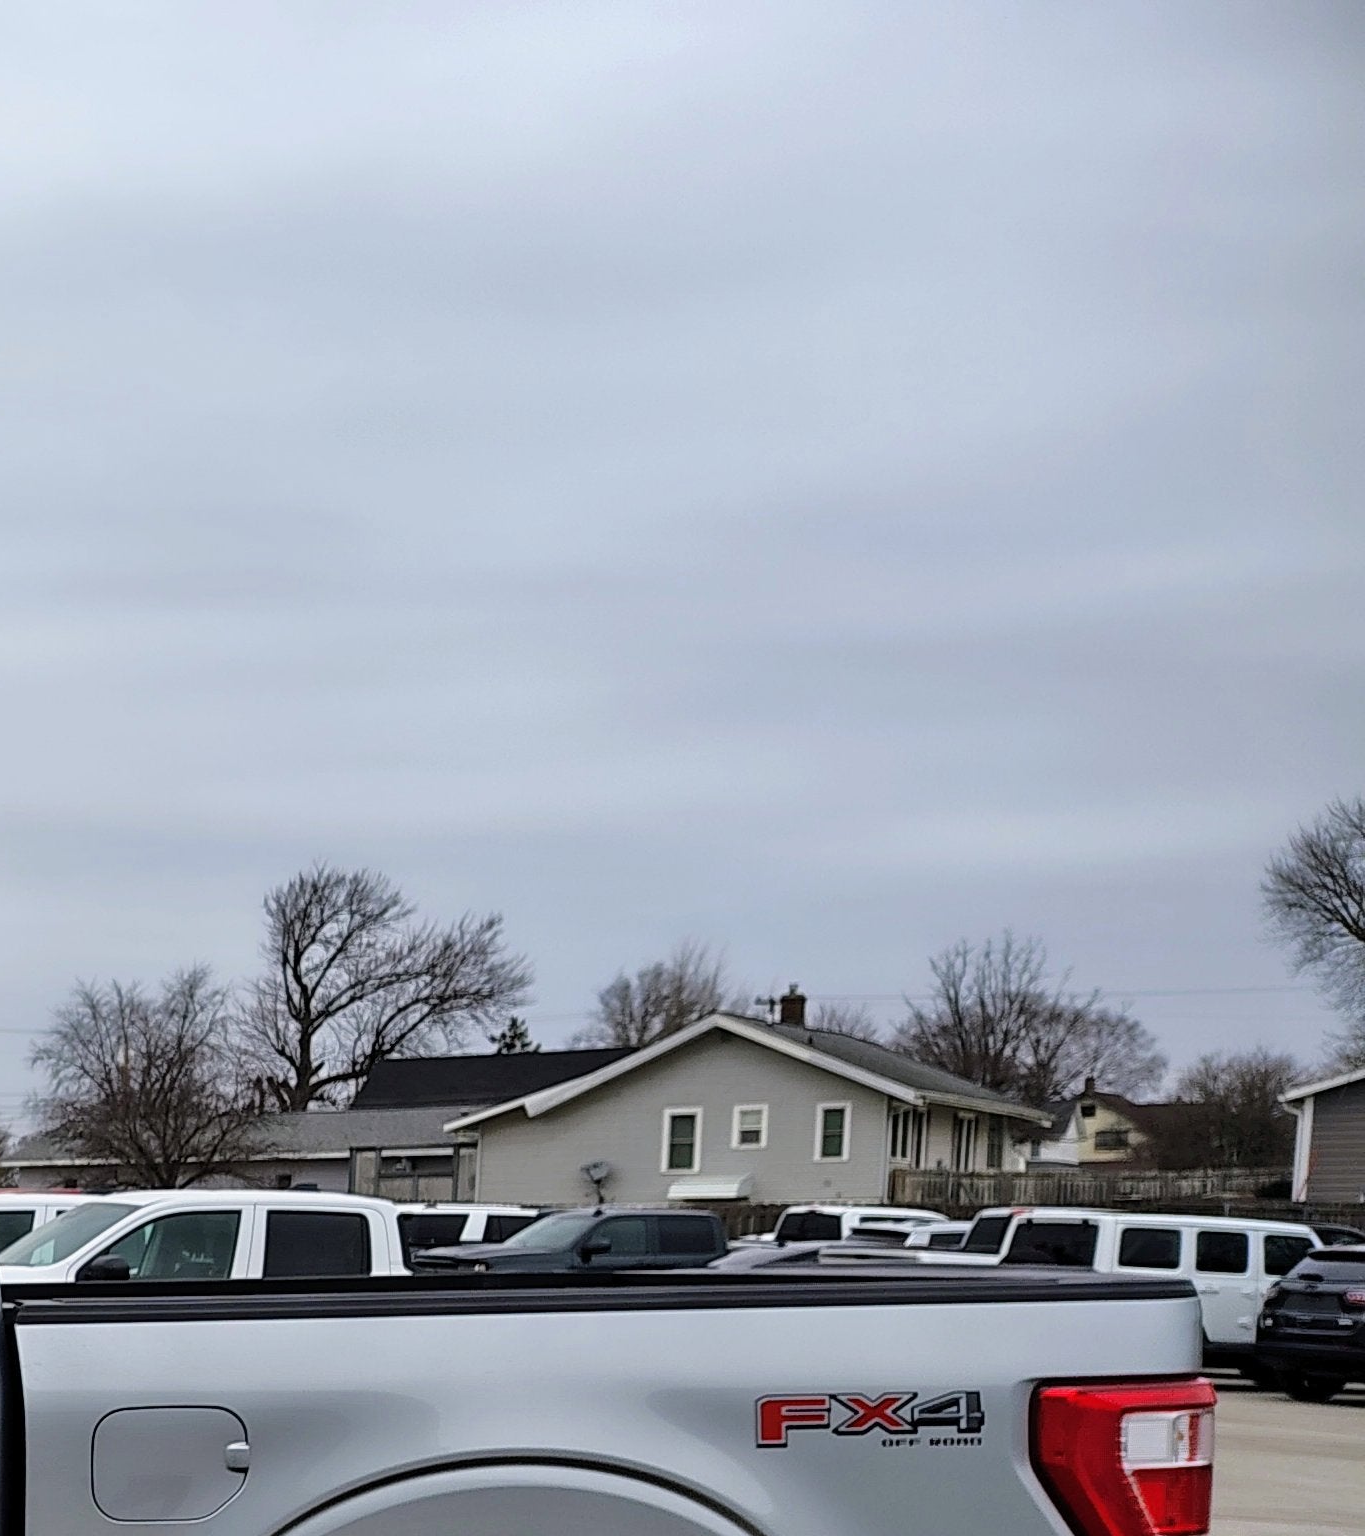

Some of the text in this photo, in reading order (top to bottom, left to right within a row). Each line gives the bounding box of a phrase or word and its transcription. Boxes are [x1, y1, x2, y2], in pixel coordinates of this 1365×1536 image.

[756, 1391, 985, 1448] FX4
[881, 1437, 982, 1448] OFF ROAD
